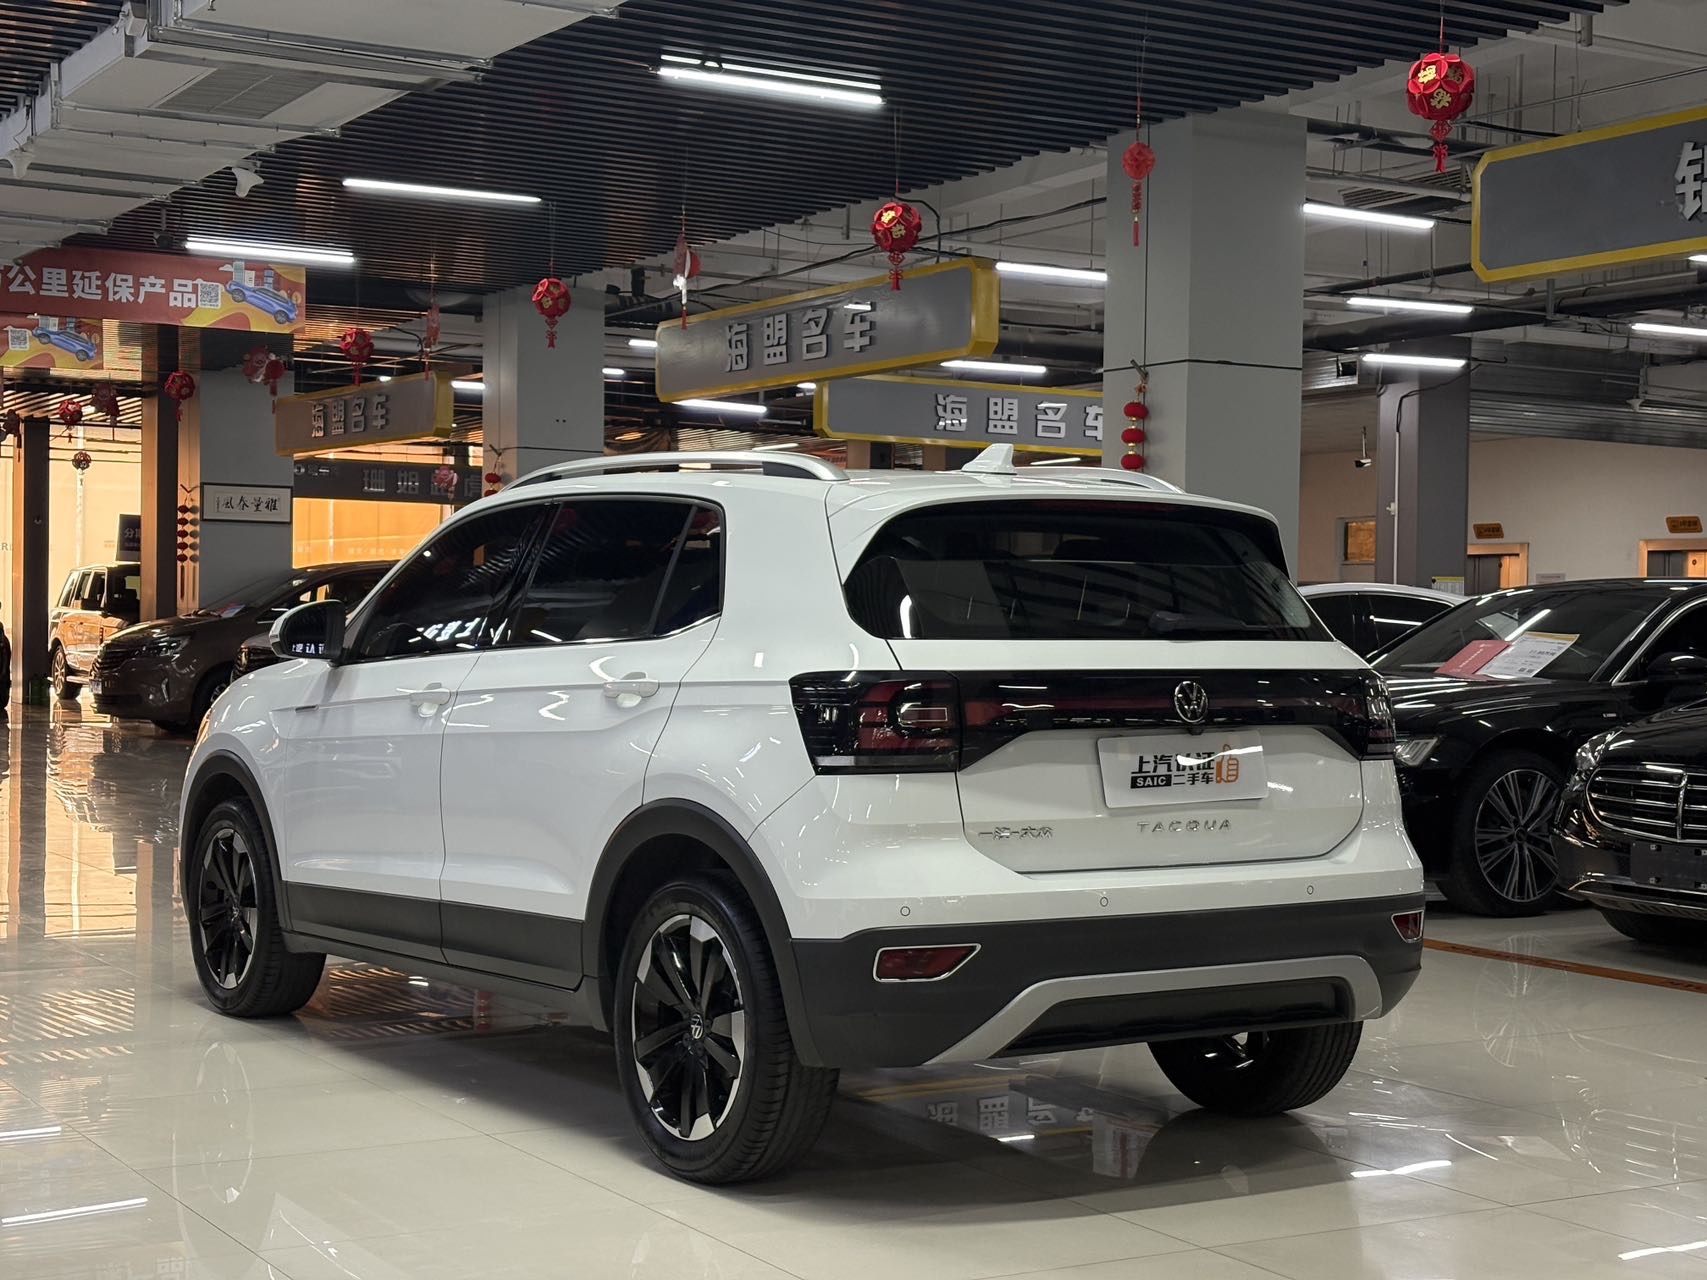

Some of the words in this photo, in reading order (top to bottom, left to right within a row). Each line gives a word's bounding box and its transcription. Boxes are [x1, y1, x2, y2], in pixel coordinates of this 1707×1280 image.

[0, 264, 197, 309] 公里延保产品
[725, 301, 873, 372] 海盟名车
[311, 394, 387, 438] 海盟名车
[936, 394, 1103, 441] 海盟名车
[1130, 752, 1216, 775] 上汽认证
[1136, 776, 1167, 787] SAIC
[1172, 772, 1215, 786] 二手车
[1136, 819, 1231, 833] TACQUA
